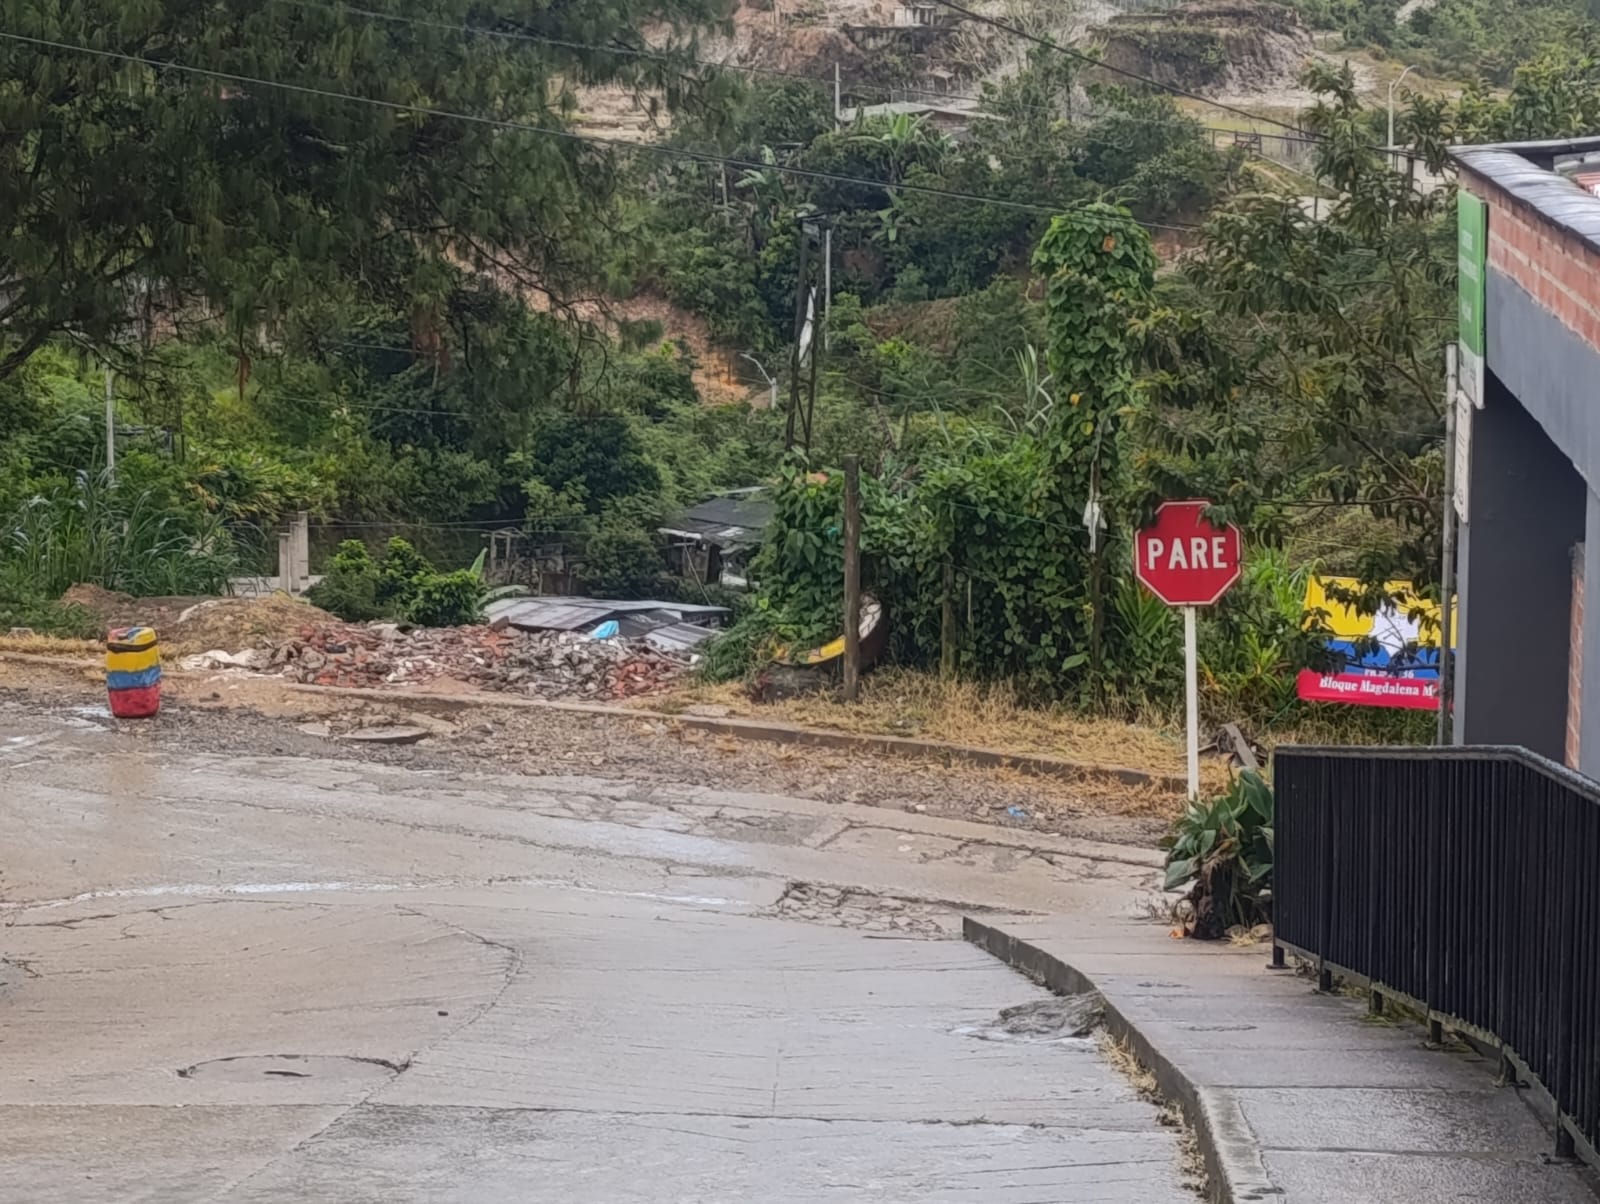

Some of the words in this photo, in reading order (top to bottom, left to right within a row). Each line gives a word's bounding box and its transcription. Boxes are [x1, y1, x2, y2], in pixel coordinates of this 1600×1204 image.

[1147, 536, 1228, 570] PARE
[1319, 676, 1358, 692] Bloque
[1360, 680, 1419, 695] Magdalena
